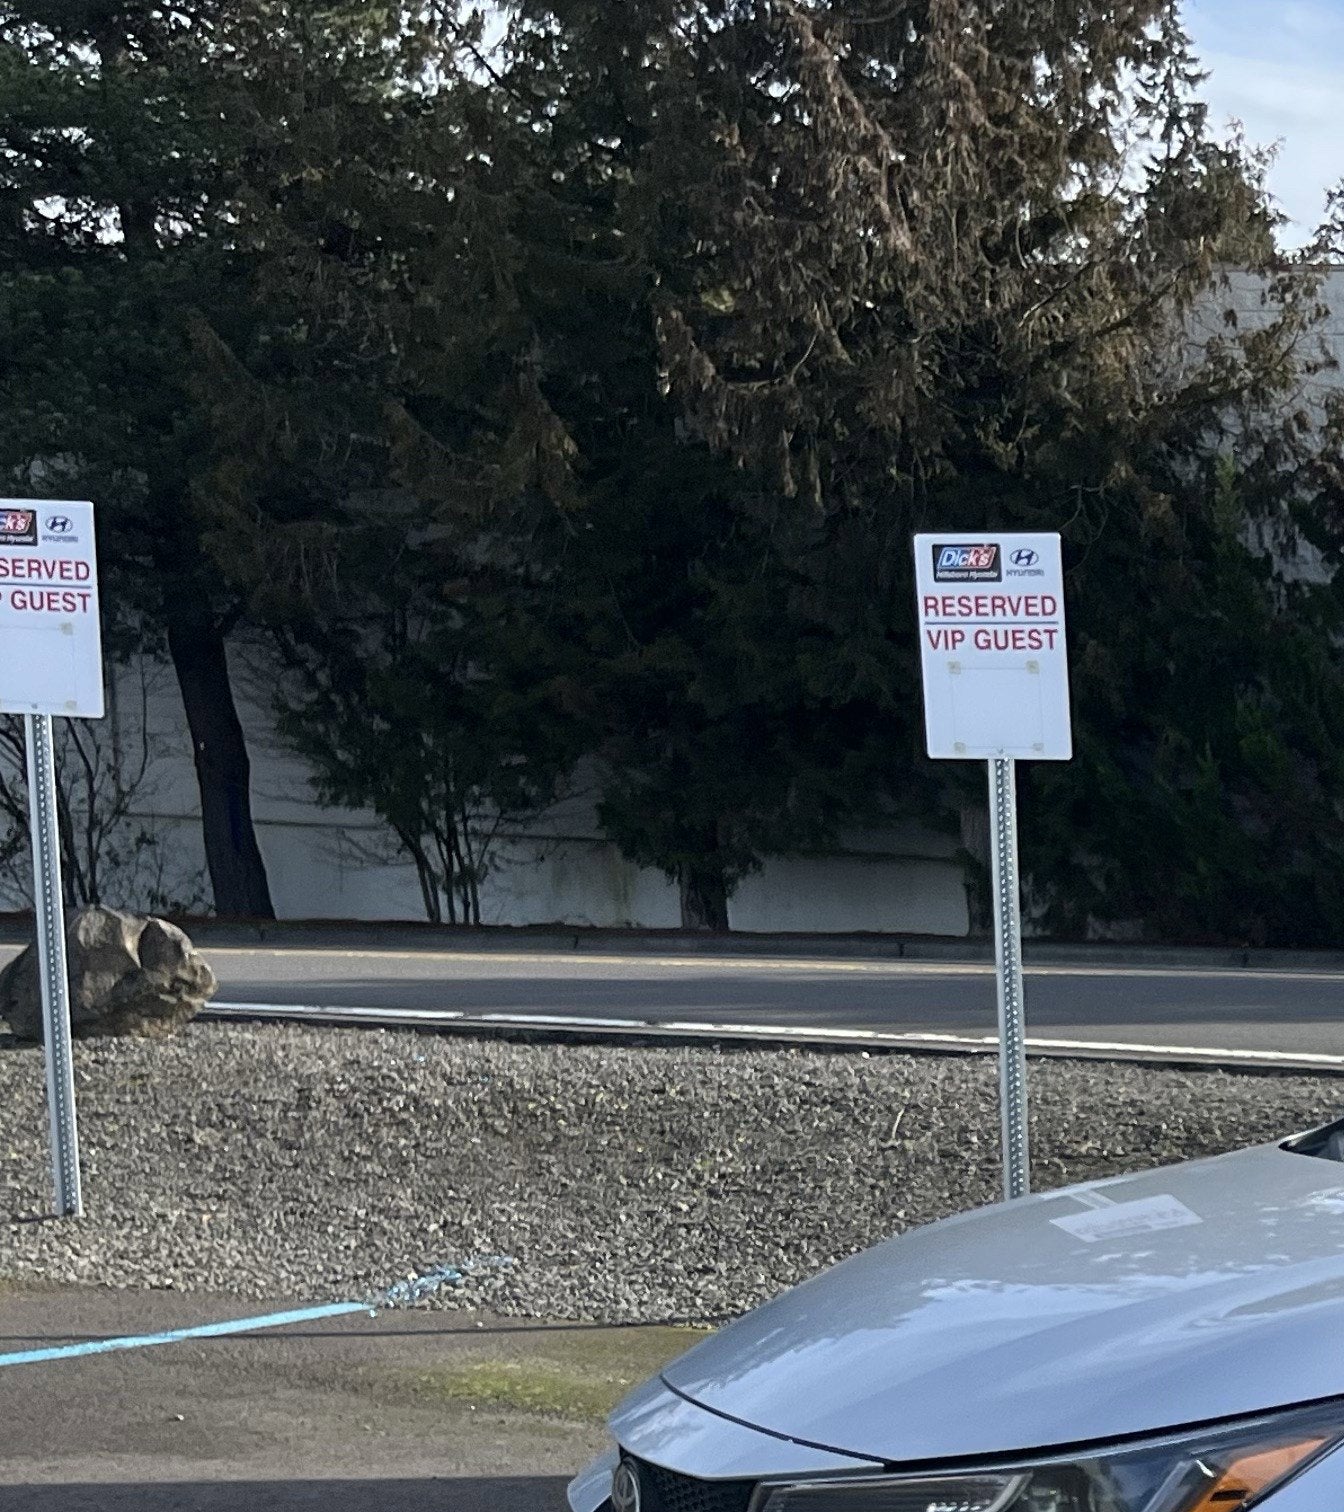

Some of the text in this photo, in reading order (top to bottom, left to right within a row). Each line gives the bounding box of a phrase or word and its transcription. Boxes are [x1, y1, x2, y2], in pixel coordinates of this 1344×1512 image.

[10, 589, 91, 613] GUEST
[923, 595, 1057, 617] RESERVED
[927, 629, 1058, 650] VIP GUEST
